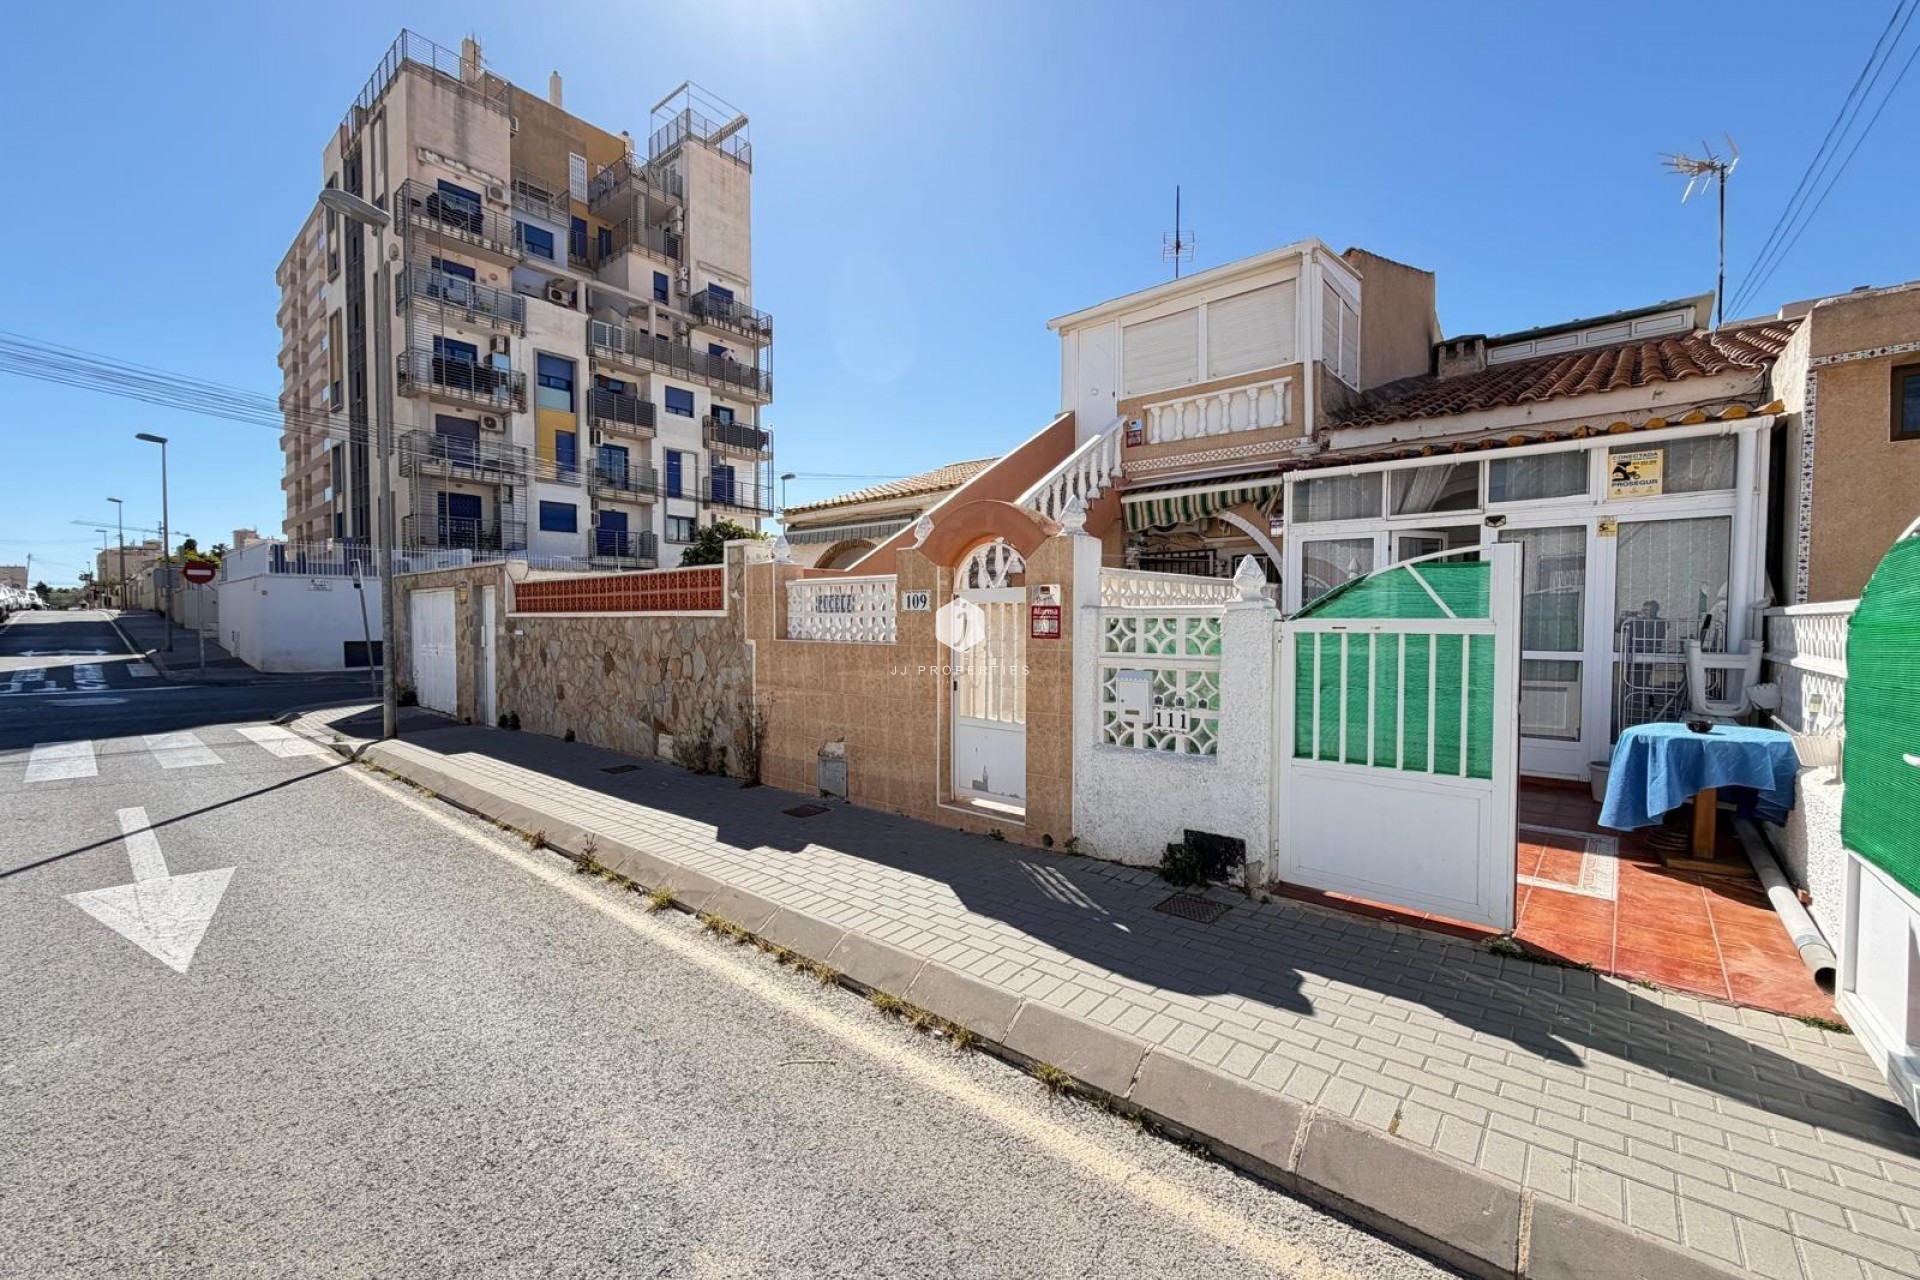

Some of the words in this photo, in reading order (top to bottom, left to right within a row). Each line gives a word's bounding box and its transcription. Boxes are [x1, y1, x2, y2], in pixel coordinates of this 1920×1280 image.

[1611, 479, 1658, 487] PROSEGUR
[906, 594, 927, 609] 109
[1033, 607, 1058, 616] Alarma
[1156, 712, 1187, 729] 111
